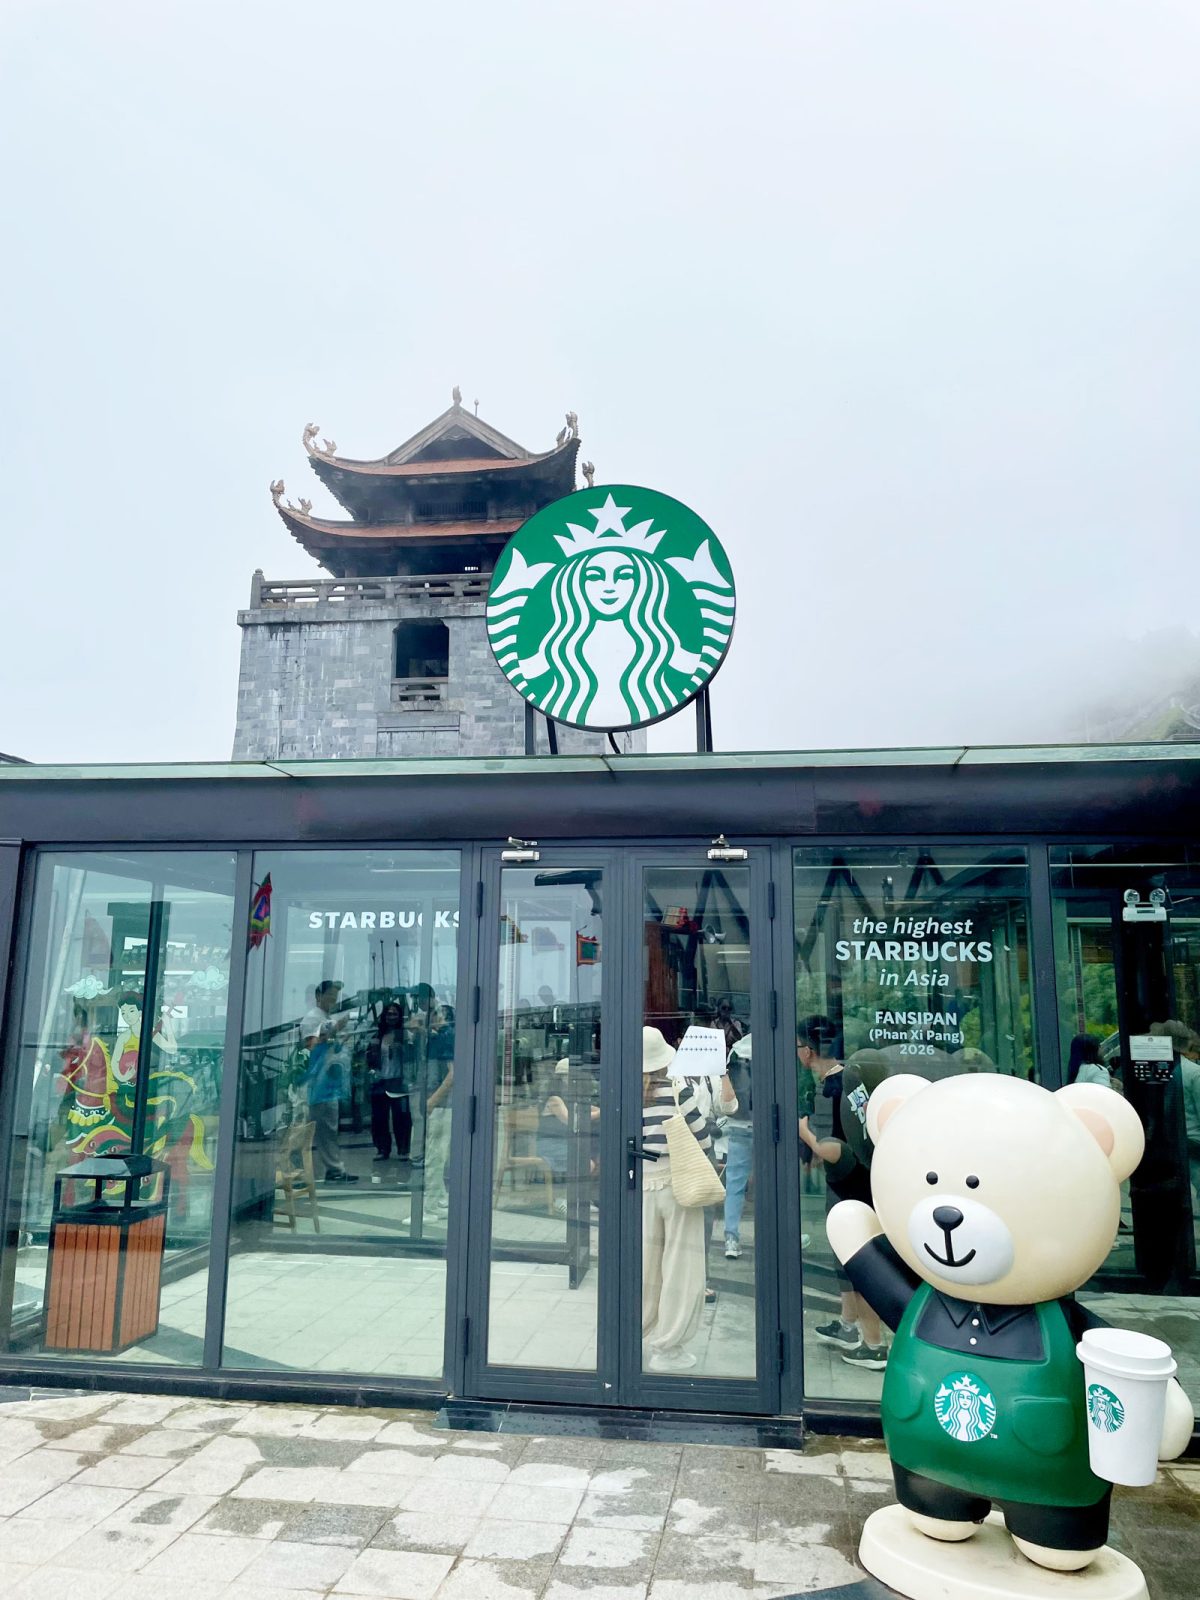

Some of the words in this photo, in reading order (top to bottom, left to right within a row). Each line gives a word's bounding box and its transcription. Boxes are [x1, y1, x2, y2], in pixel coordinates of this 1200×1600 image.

[853, 917, 887, 934] the
[893, 917, 973, 938] highest
[836, 941, 993, 962] STARBUCKS
[879, 969, 899, 986] in
[904, 969, 949, 986] Asia
[875, 1011, 957, 1025] FANSIPAN
[869, 1029, 907, 1042] (Phan
[911, 1030, 923, 1041] Xi
[926, 1031, 965, 1044] Pang)
[900, 1044, 935, 1055] 2026
